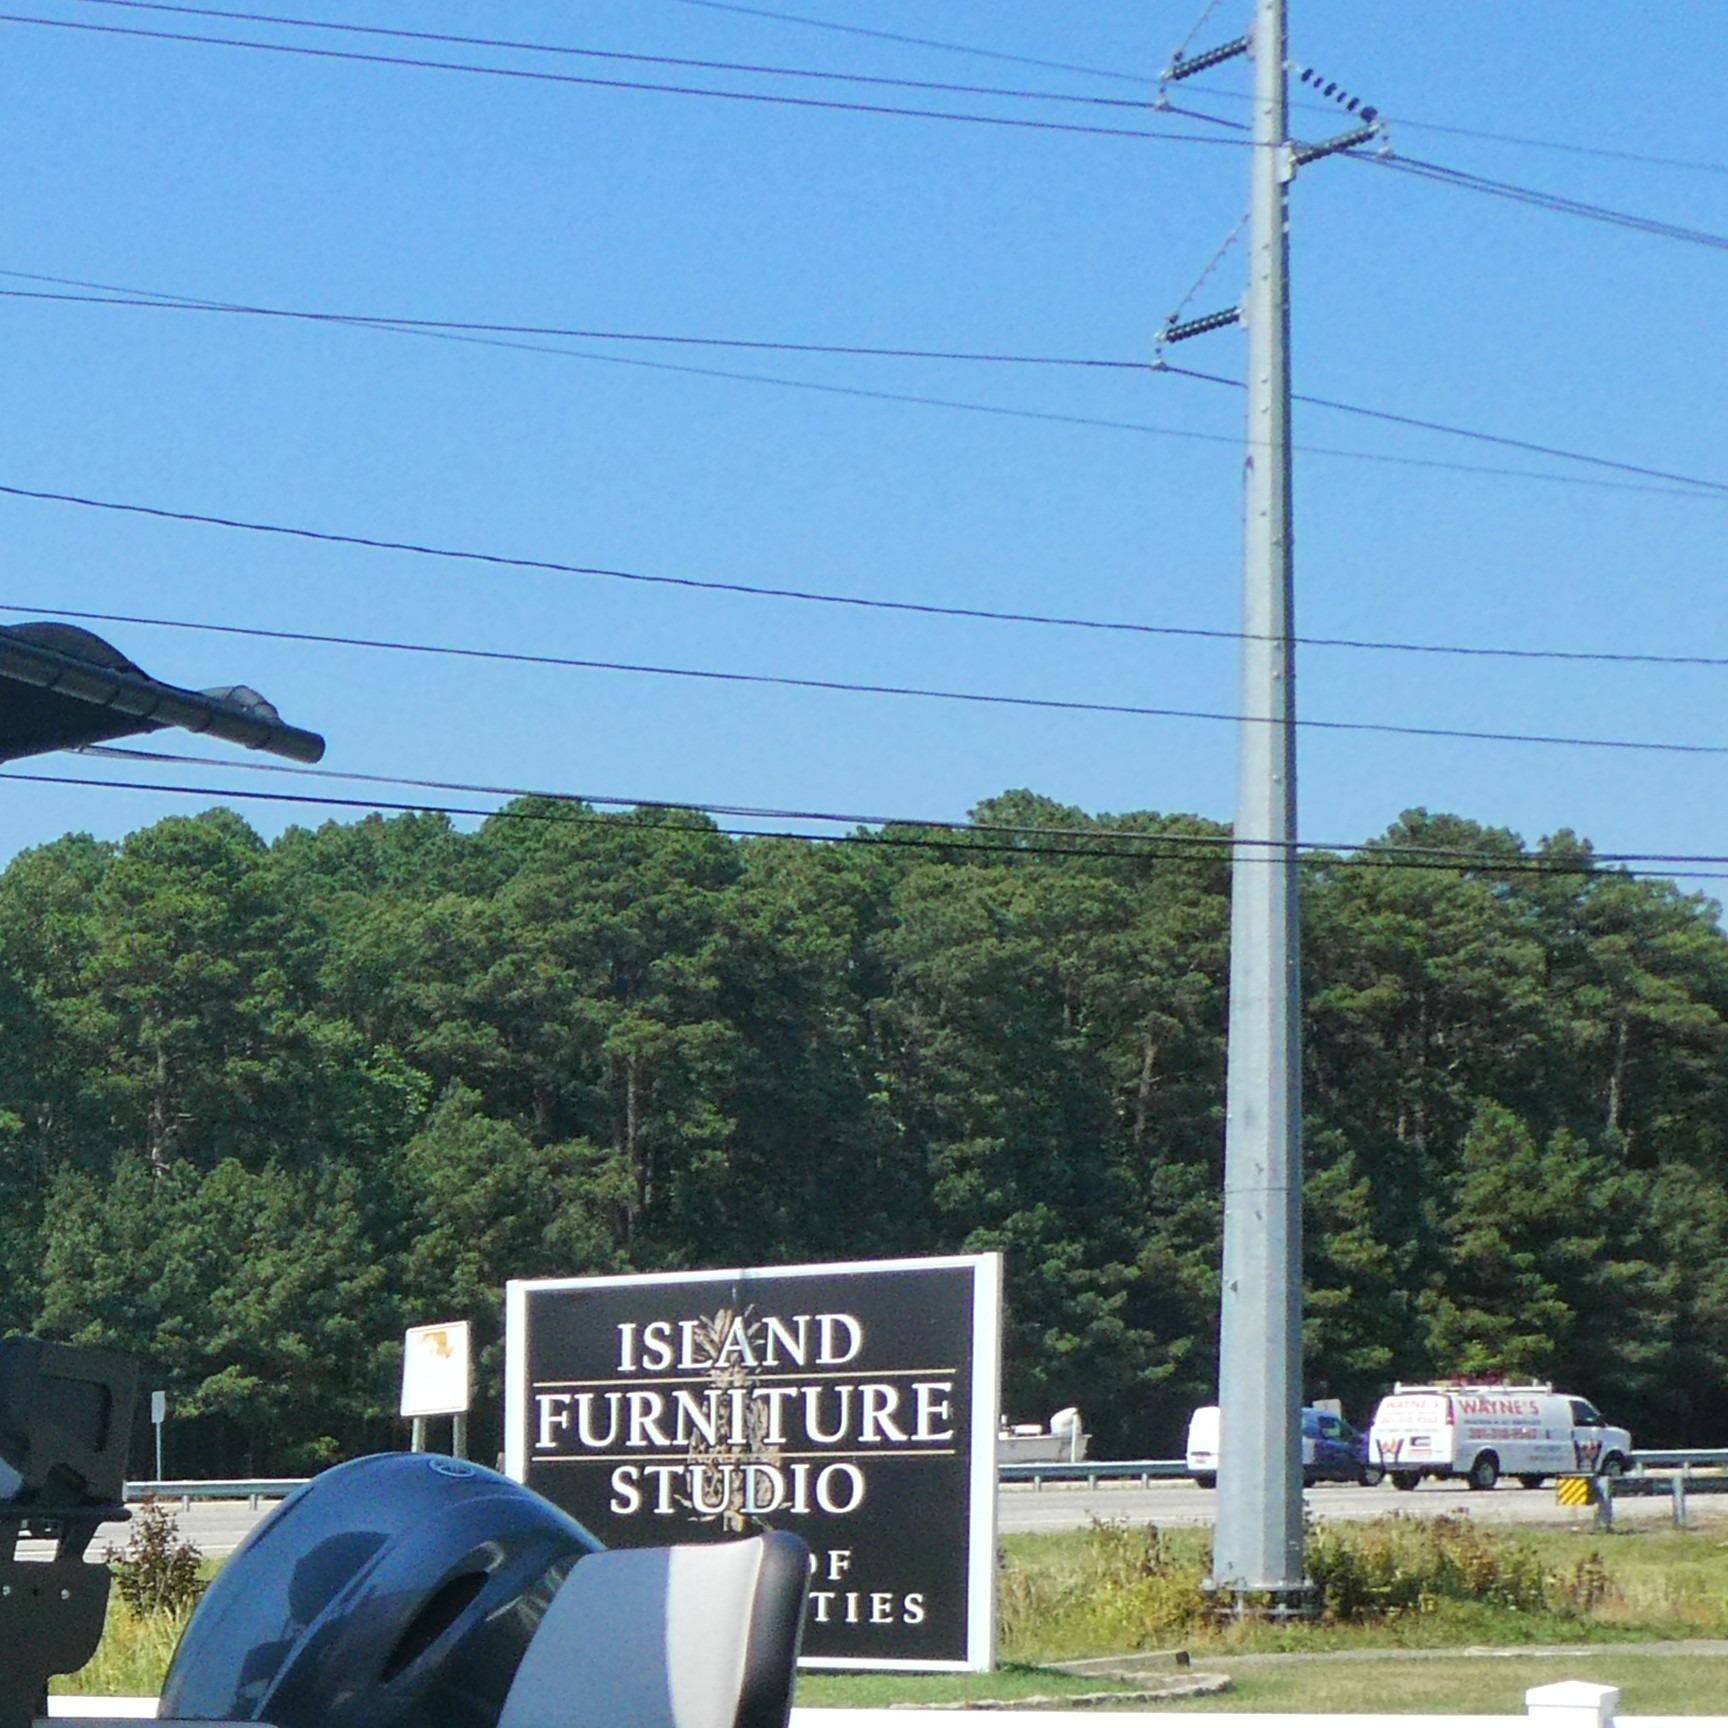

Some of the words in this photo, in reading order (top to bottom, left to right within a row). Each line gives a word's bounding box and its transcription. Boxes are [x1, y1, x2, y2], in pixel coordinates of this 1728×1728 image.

[617, 1313, 862, 1371] ISLAND
[534, 1381, 954, 1449] FURNITURE
[1459, 1399, 1540, 1415] WAYNE'S
[610, 1464, 865, 1515] STUDIO
